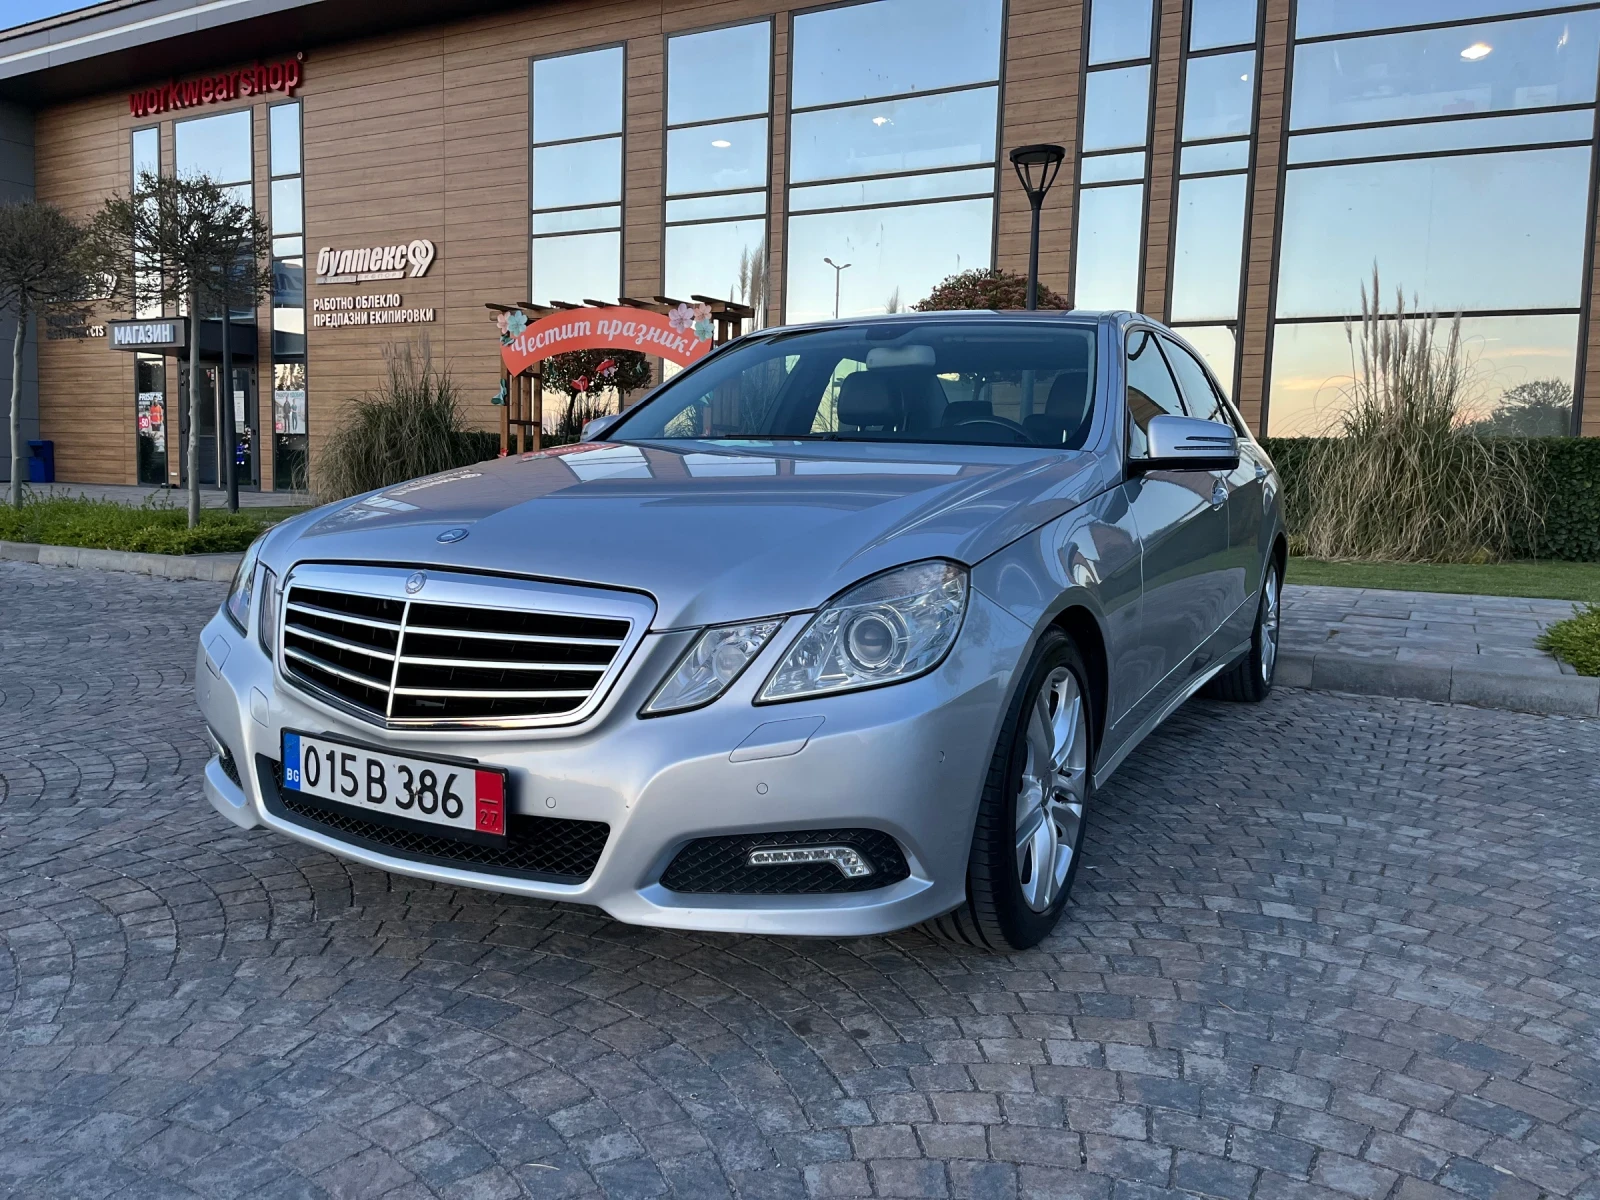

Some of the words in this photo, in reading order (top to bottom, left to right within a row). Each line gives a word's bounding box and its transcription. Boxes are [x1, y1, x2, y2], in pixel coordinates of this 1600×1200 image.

[129, 60, 299, 116] workwearshop
[313, 296, 354, 311] РАБОТНО
[355, 293, 401, 309] ОБЛЕКЛО
[313, 311, 368, 327] ПРЕДПАЗНИ
[369, 309, 433, 323] ЕКИПИРОВКИ
[114, 323, 171, 345] МАГАЗИН
[511, 320, 591, 356] Честит
[596, 319, 700, 357] празник!
[286, 767, 300, 783] BG
[479, 808, 498, 827] 27
